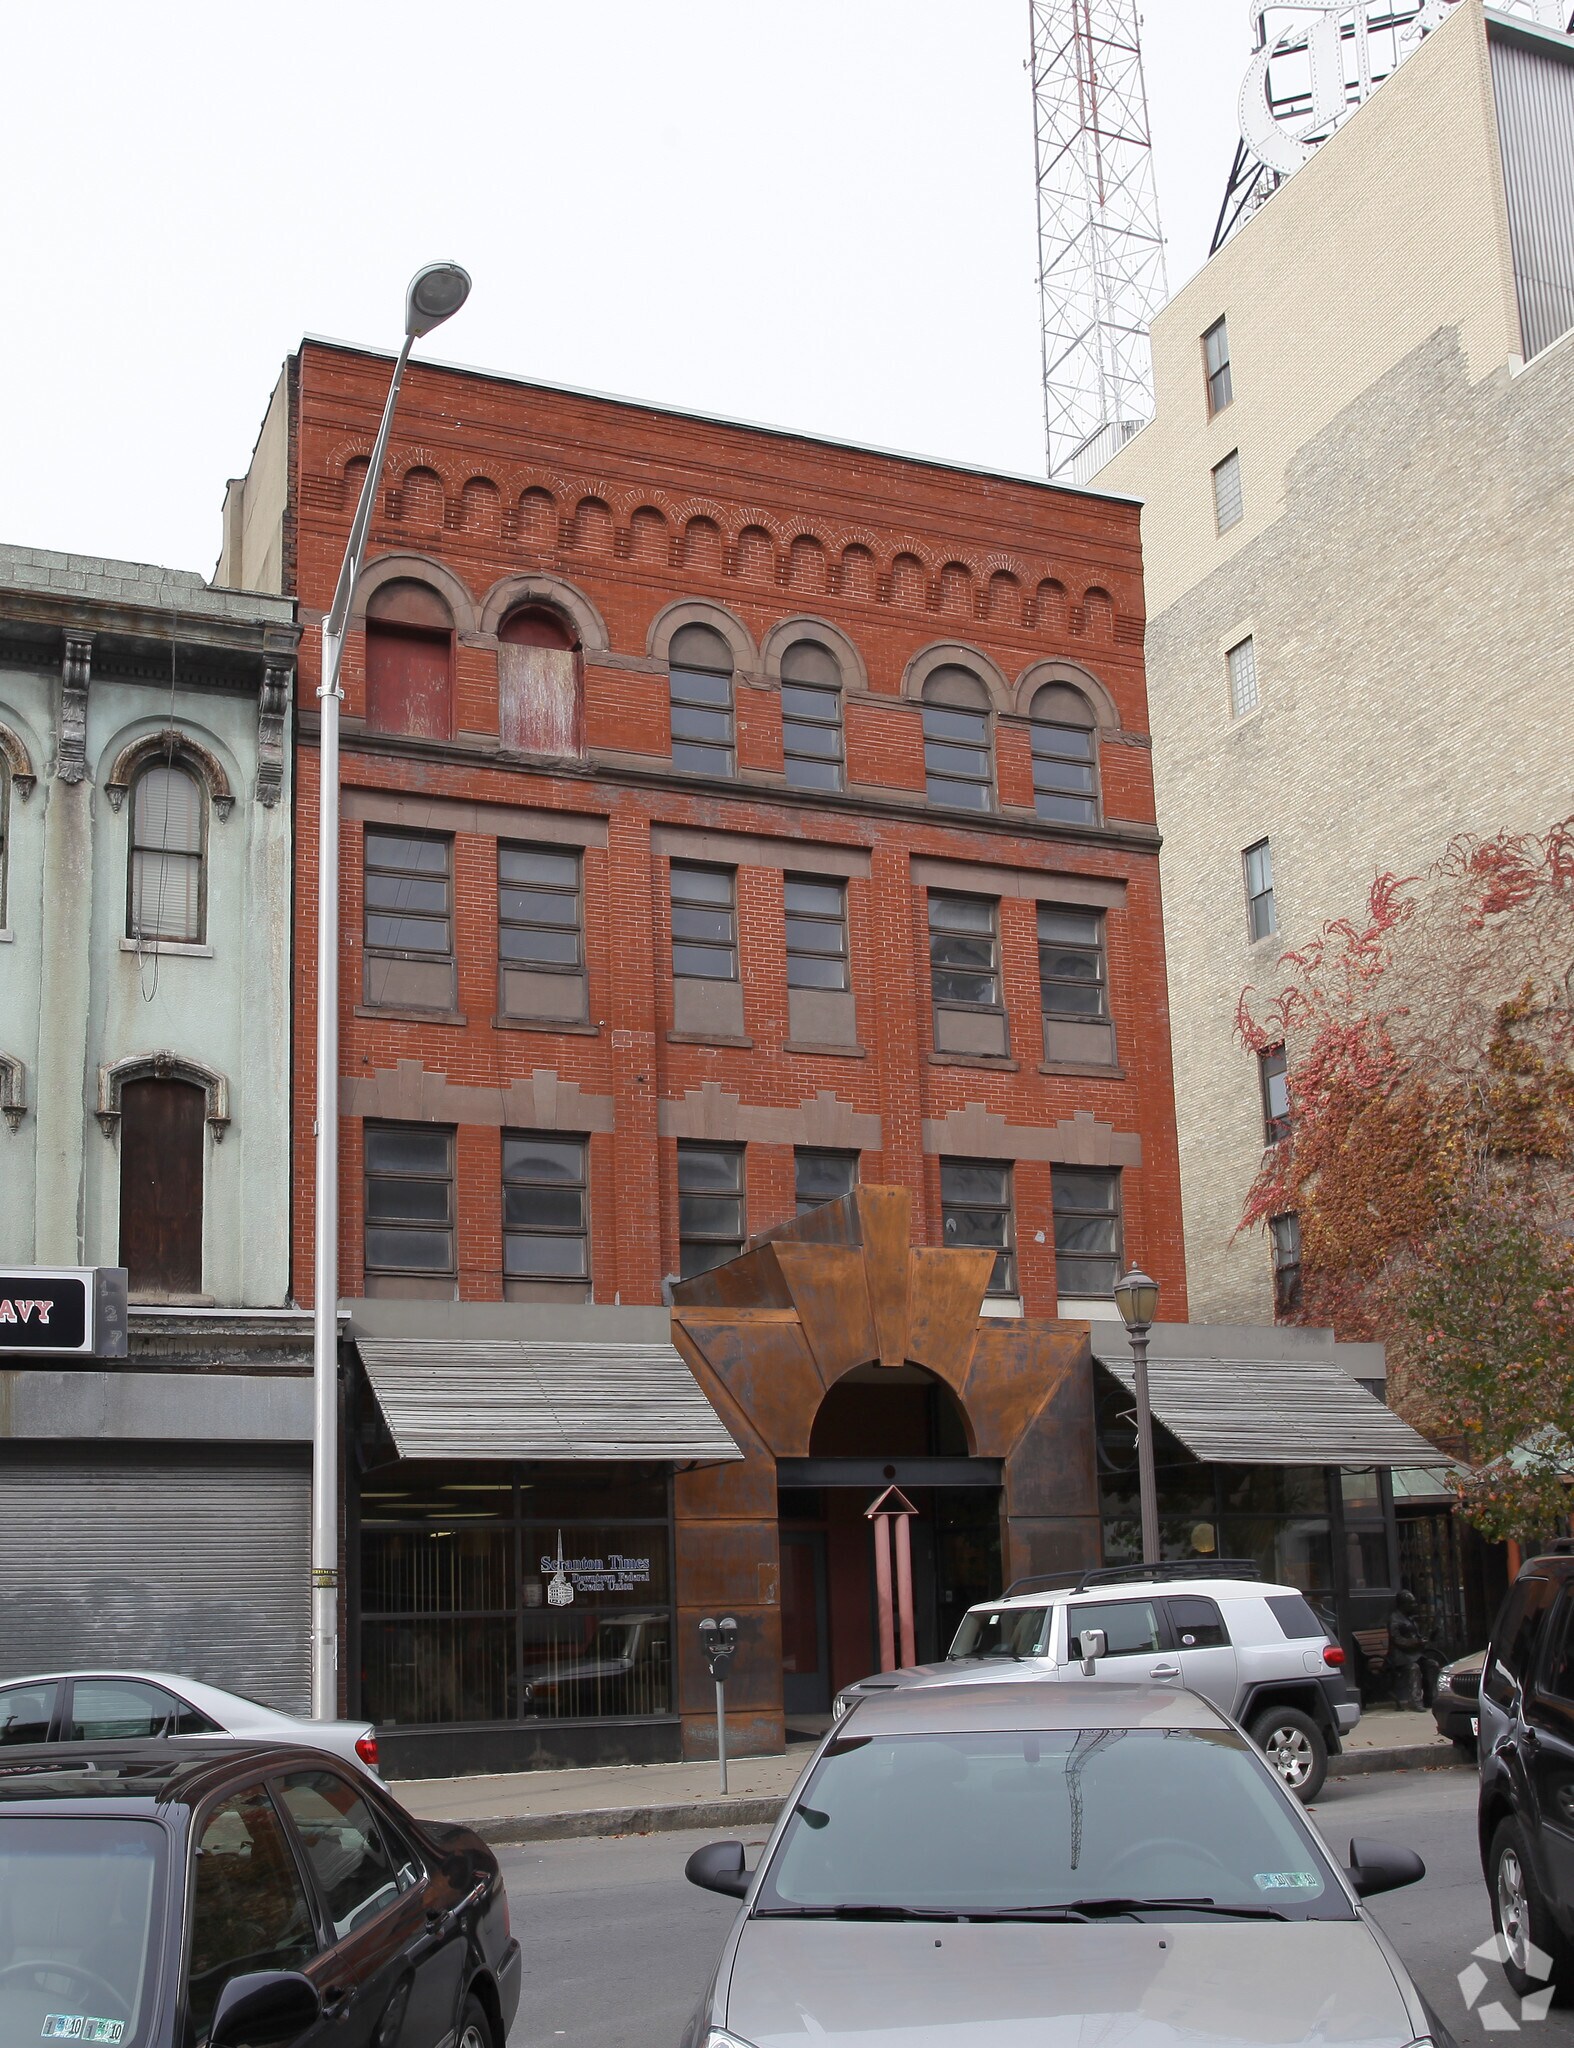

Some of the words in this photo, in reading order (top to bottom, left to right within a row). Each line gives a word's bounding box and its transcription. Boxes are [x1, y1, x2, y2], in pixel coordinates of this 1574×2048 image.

[0, 1299, 54, 1324] AVY
[540, 1555, 604, 1571] Scranton
[608, 1554, 650, 1570] Times
[571, 1573, 616, 1583] Downtown
[618, 1572, 650, 1582] Federal
[576, 1582, 605, 1592] Credit
[607, 1581, 634, 1591] Union
[69, 2018, 82, 2035] 10
[109, 2023, 122, 2040] 10
